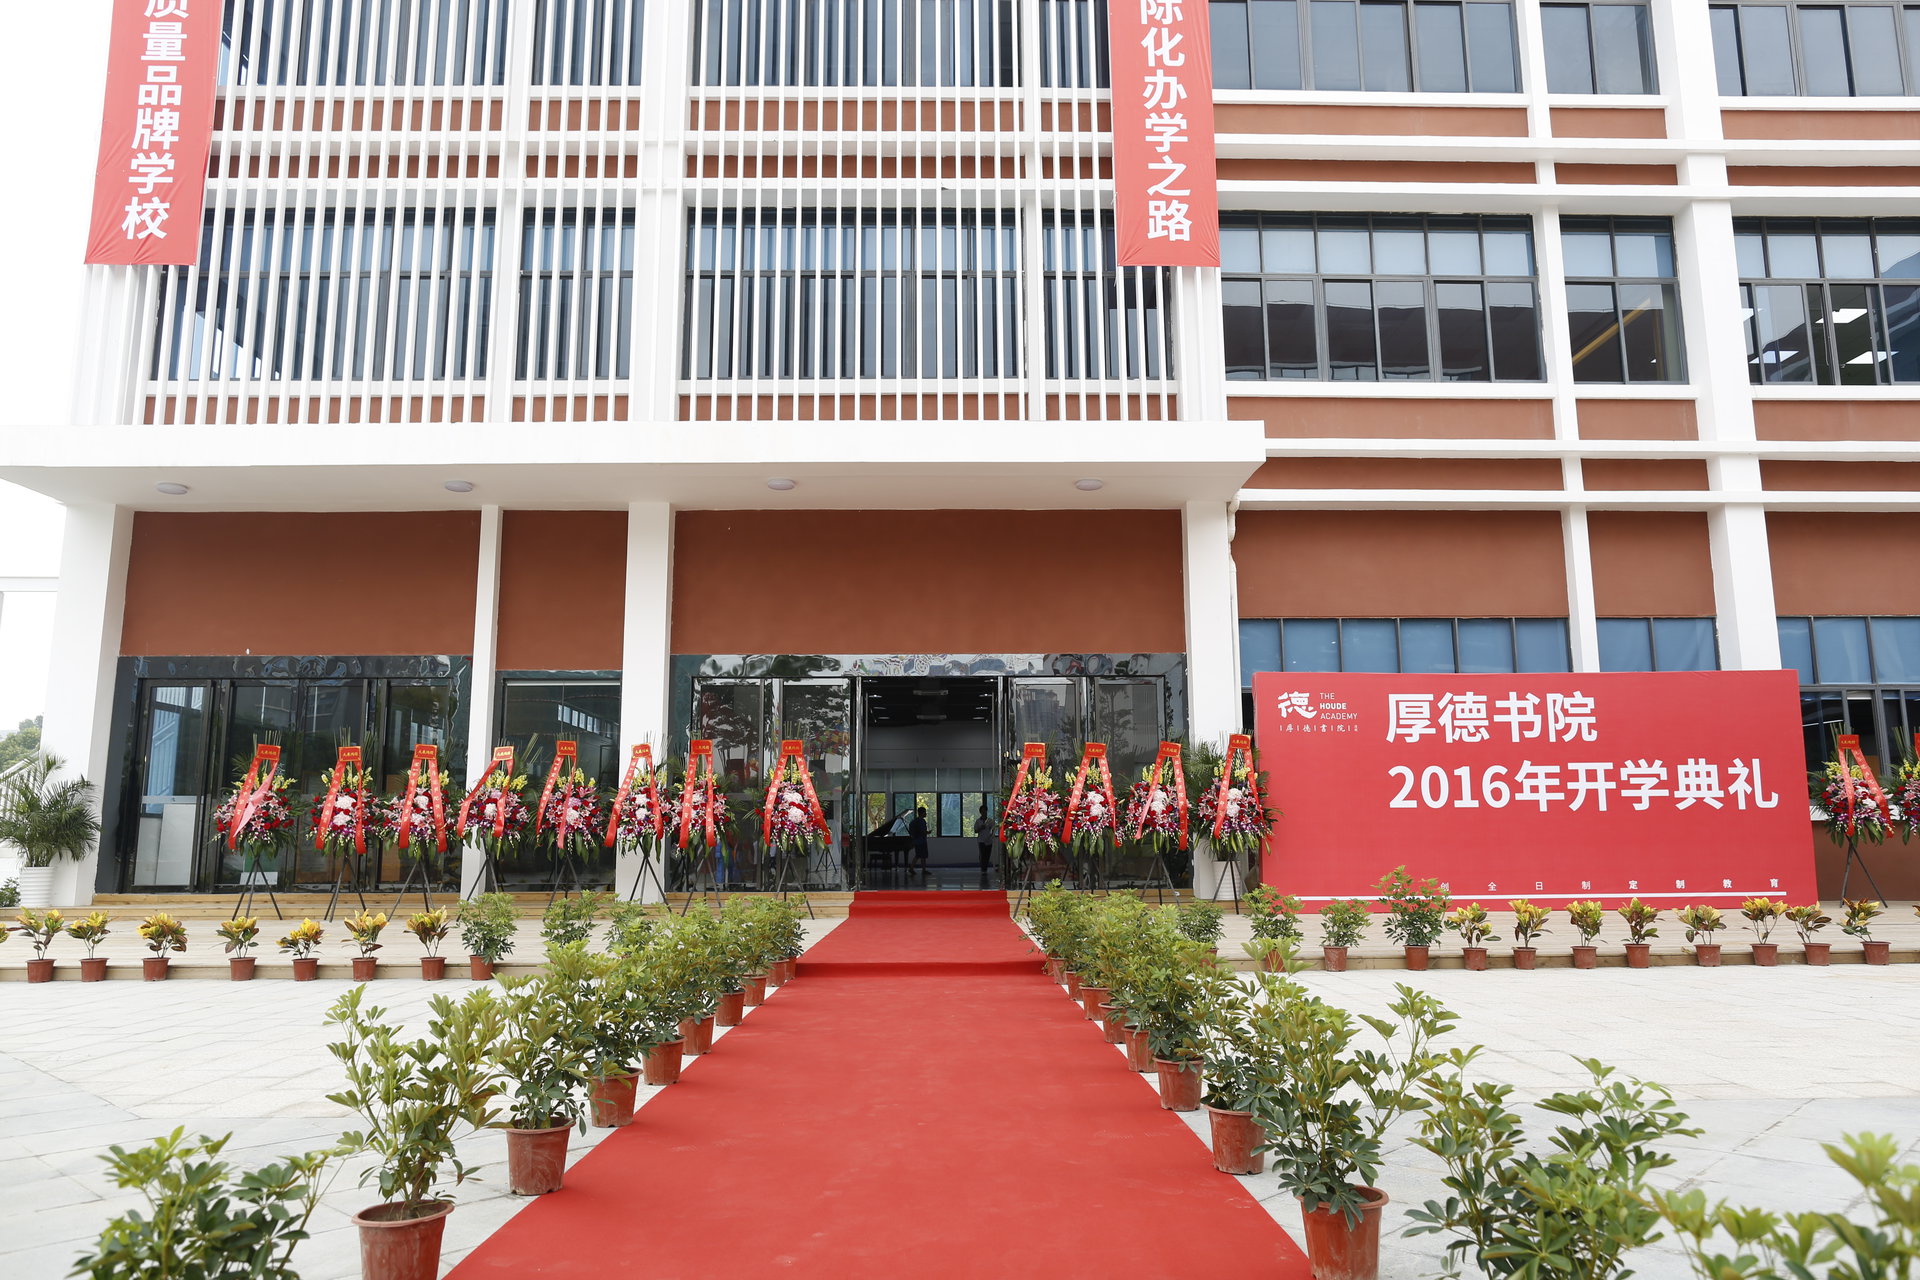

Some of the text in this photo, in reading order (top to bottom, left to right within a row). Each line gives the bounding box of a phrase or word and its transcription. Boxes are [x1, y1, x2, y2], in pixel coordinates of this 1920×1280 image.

[1140, 0, 1193, 242] 际化办学之路
[1319, 692, 1335, 700] THE
[1319, 702, 1347, 710] HOUDE
[1320, 712, 1358, 720] ACADEMY
[1385, 690, 1598, 744] 厚德书院
[1387, 757, 1779, 812] 2016年开学典礼
